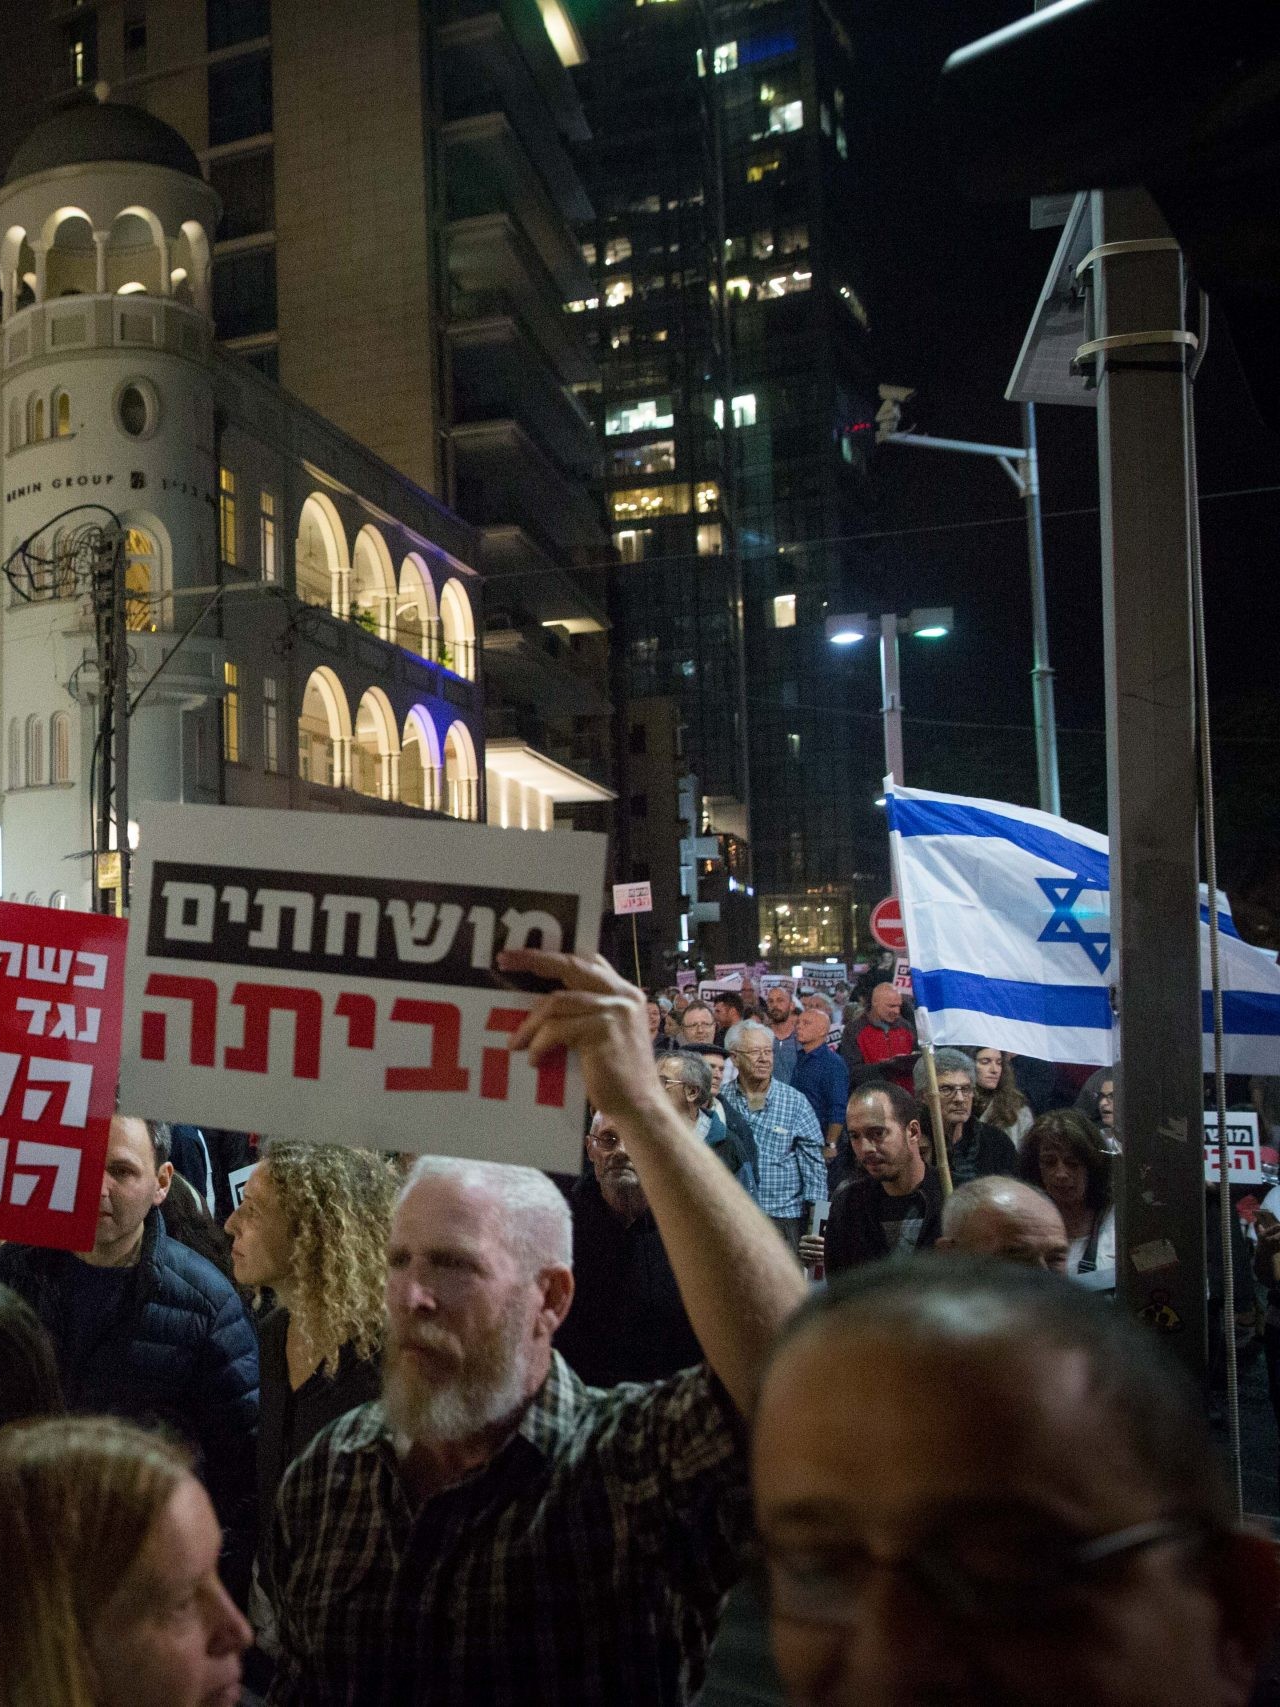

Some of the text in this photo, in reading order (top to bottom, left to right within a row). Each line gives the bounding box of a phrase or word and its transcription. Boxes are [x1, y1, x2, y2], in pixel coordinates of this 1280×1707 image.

[51, 474, 114, 489] GROUP
[161, 880, 563, 970] מושחתים
[15, 997, 101, 1044] נגד
[141, 973, 568, 1108] הביתה
